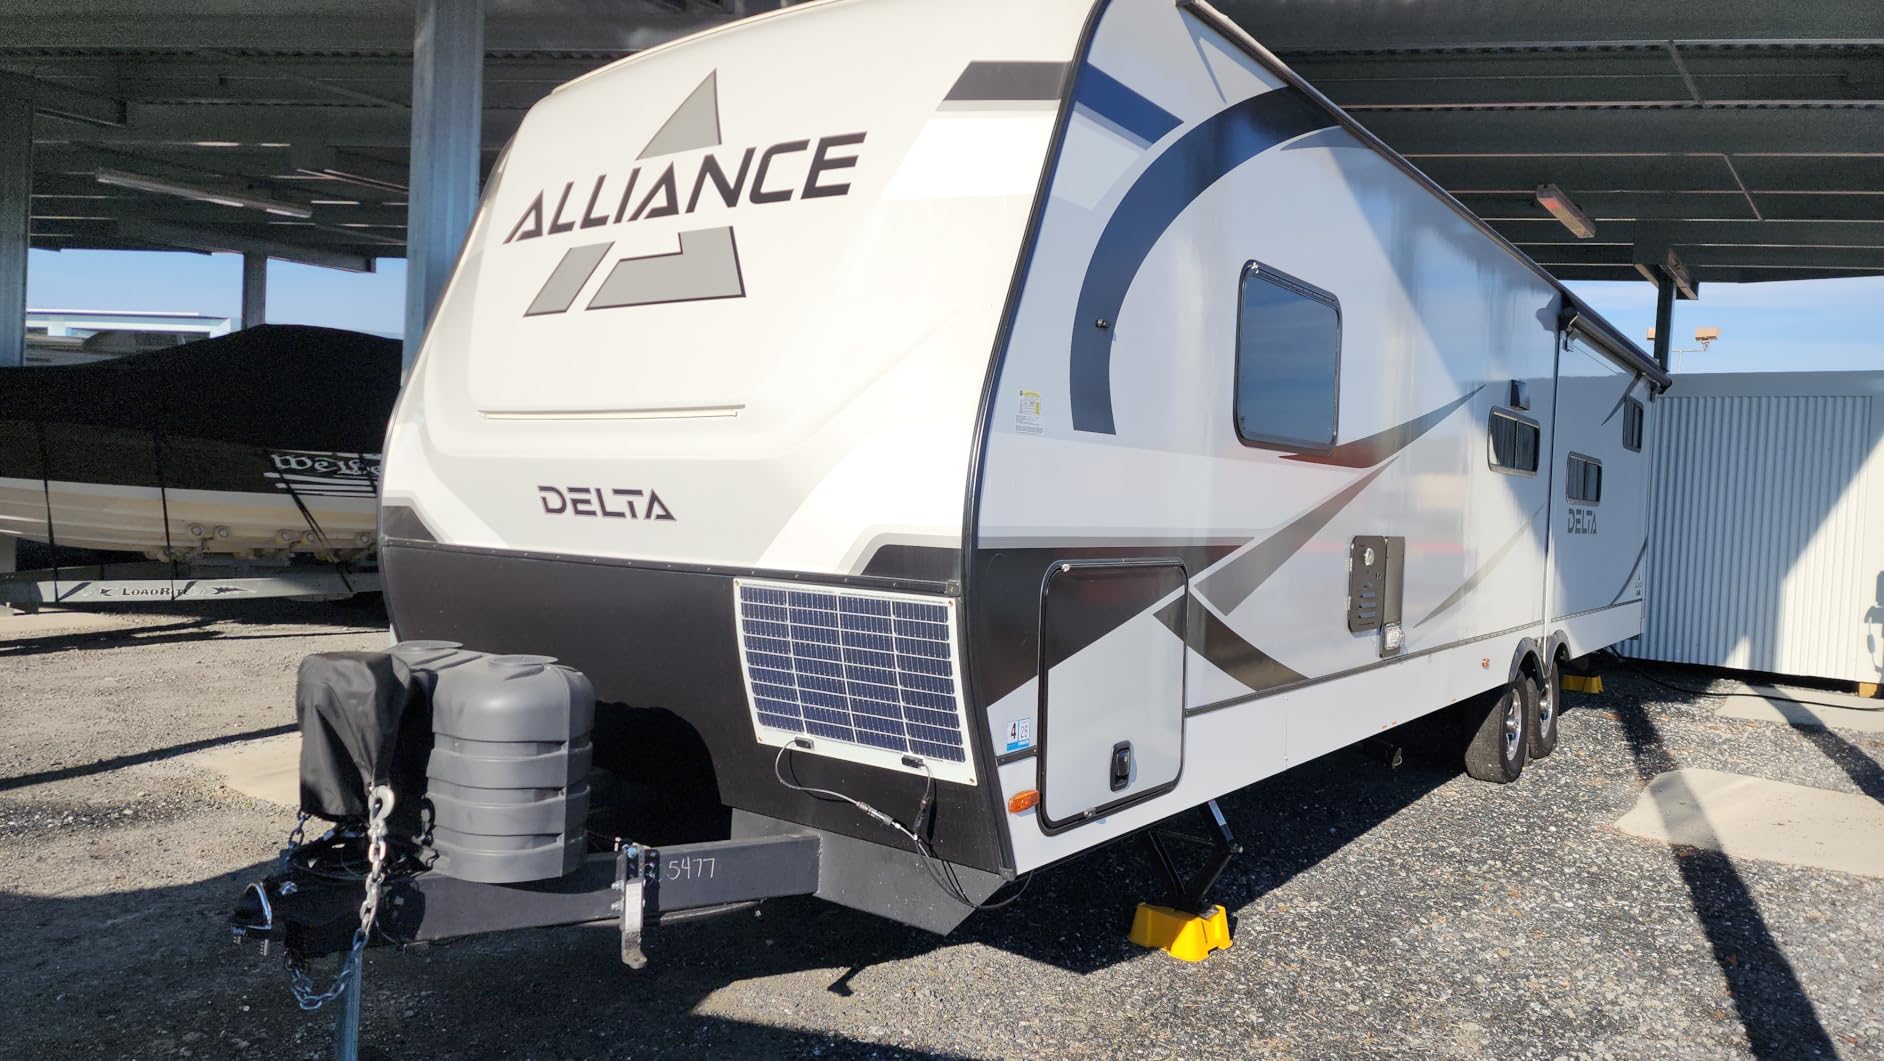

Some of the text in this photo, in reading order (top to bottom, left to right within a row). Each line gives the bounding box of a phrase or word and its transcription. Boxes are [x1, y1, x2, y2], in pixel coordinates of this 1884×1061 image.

[502, 131, 868, 245] ALLIANCE
[537, 485, 677, 521] DELTA
[1567, 507, 1598, 535] DELTA
[1010, 722, 1017, 740] 4
[666, 856, 715, 880] 5477
